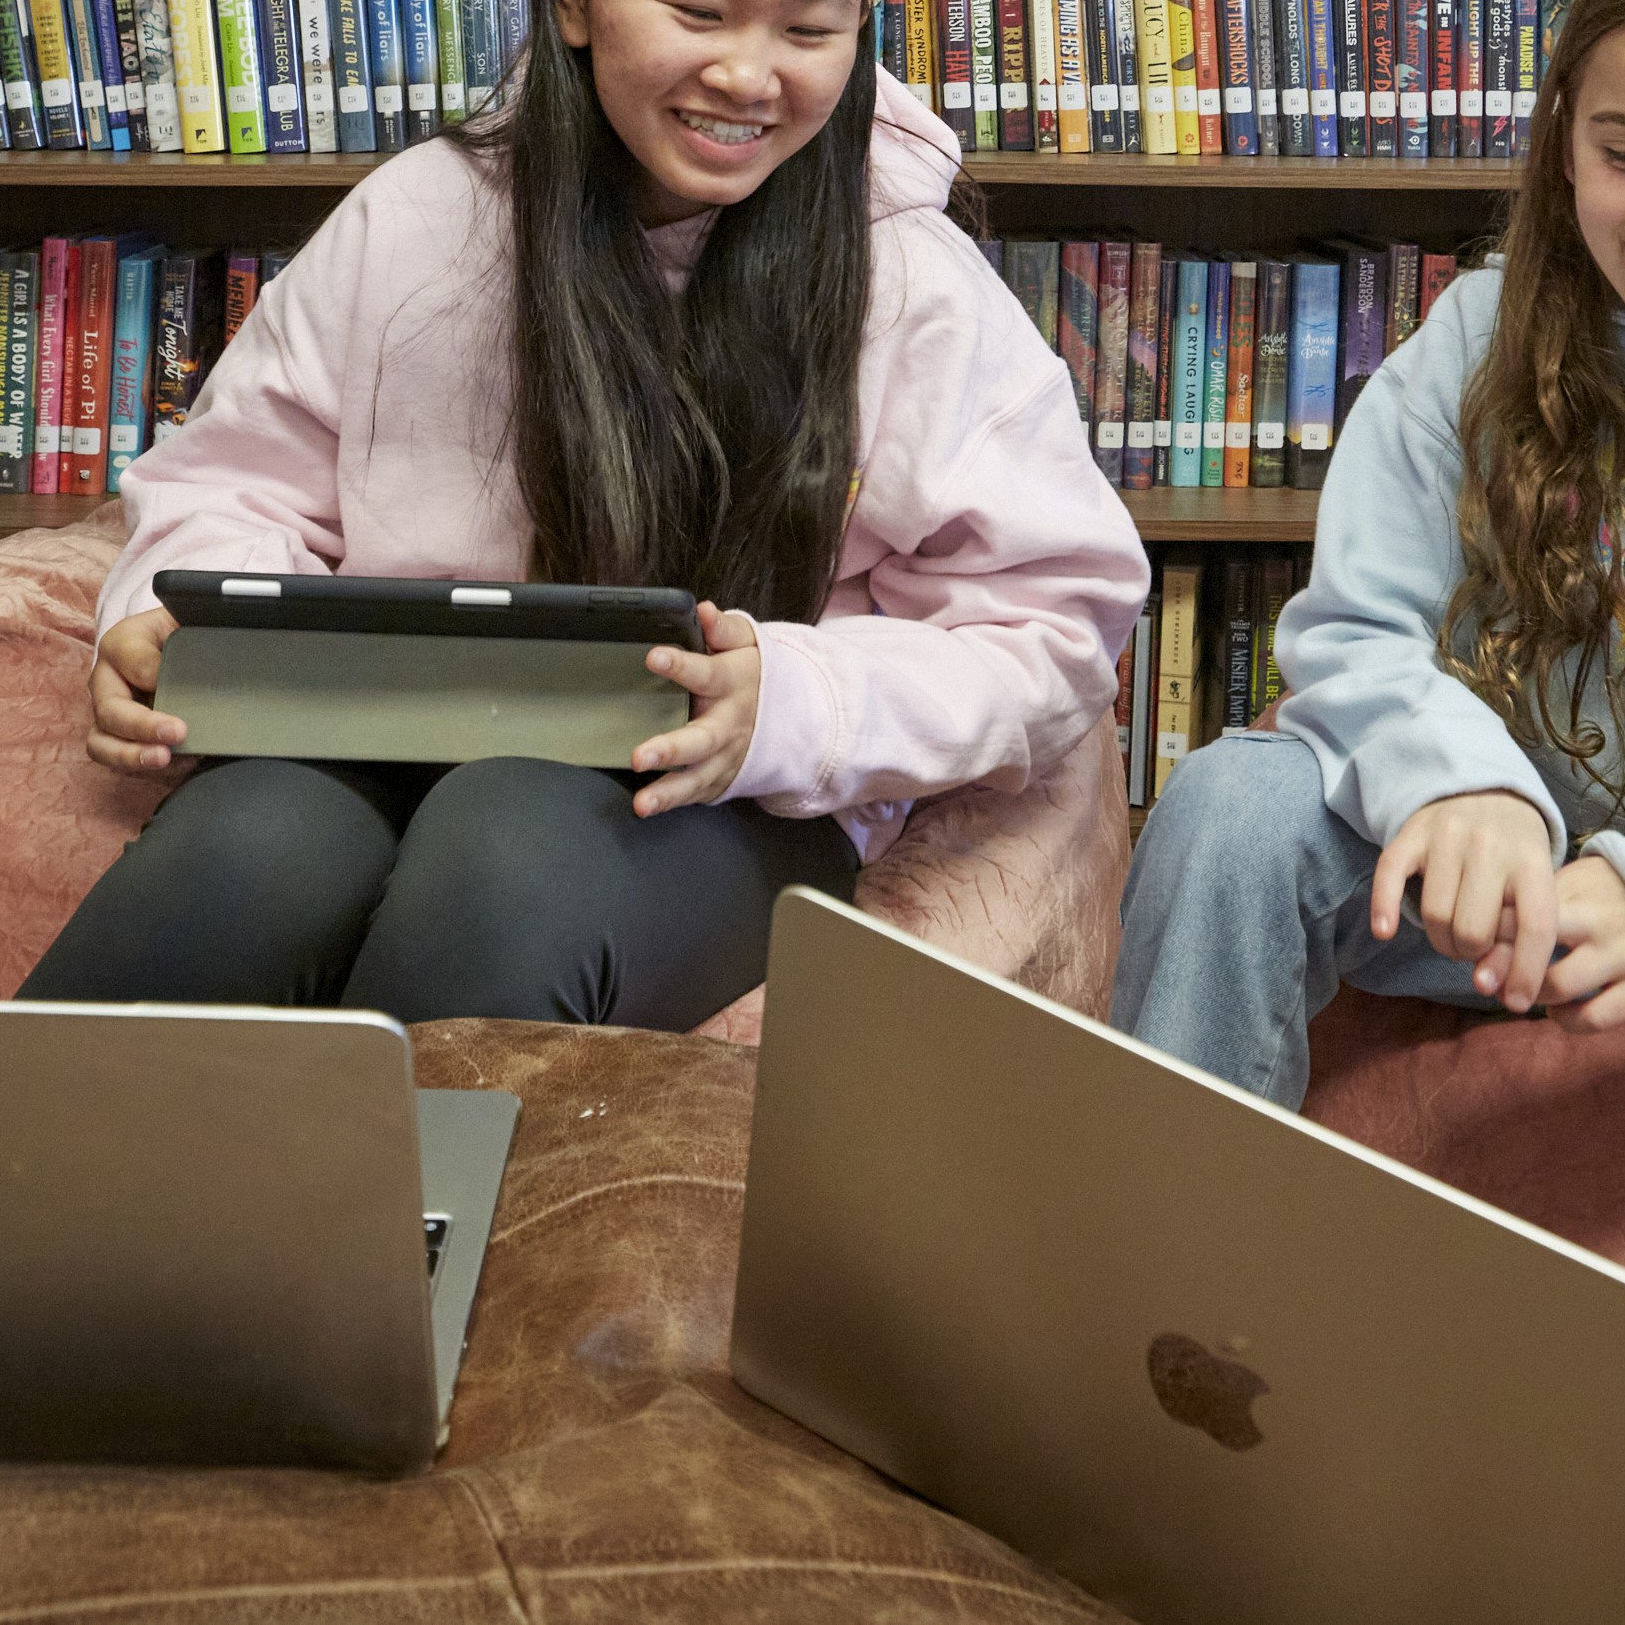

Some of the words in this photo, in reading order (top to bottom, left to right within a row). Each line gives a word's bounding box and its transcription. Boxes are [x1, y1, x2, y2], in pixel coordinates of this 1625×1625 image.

[342, 17, 354, 44] FALLS
[413, 13, 423, 28] of
[1468, 0, 1480, 37] LIGHT
[1492, 7, 1502, 36] gods
[347, 52, 356, 63] TO
[415, 32, 426, 63] liars
[1040, 36, 1048, 74] HEAVEN
[1062, 36, 1078, 55] AS
[1372, 36, 1391, 77] SHOT
[1469, 40, 1480, 59] UP
[477, 53, 486, 74] SON
[1260, 39, 1271, 88] SCHOOL
[1289, 54, 1300, 85] LONG
[1469, 62, 1480, 84] THE
[13, 283, 27, 308] GIRL
[175, 285, 184, 302] TAKE
[1358, 258, 1368, 313] SANDERSON
[1366, 263, 1374, 310] BRANDON
[43, 294, 58, 323] What
[166, 291, 175, 312] HOME
[13, 329, 27, 338] A
[40, 327, 56, 357] Every
[13, 344, 27, 383] BODY
[83, 330, 98, 369] Life
[159, 319, 186, 380] Tonight
[1186, 327, 1198, 377] CRYING
[41, 361, 56, 384] Girl
[81, 374, 93, 393] of
[11, 390, 25, 408] OF
[81, 401, 96, 420] Pi
[1228, 649, 1248, 693] MISTER
